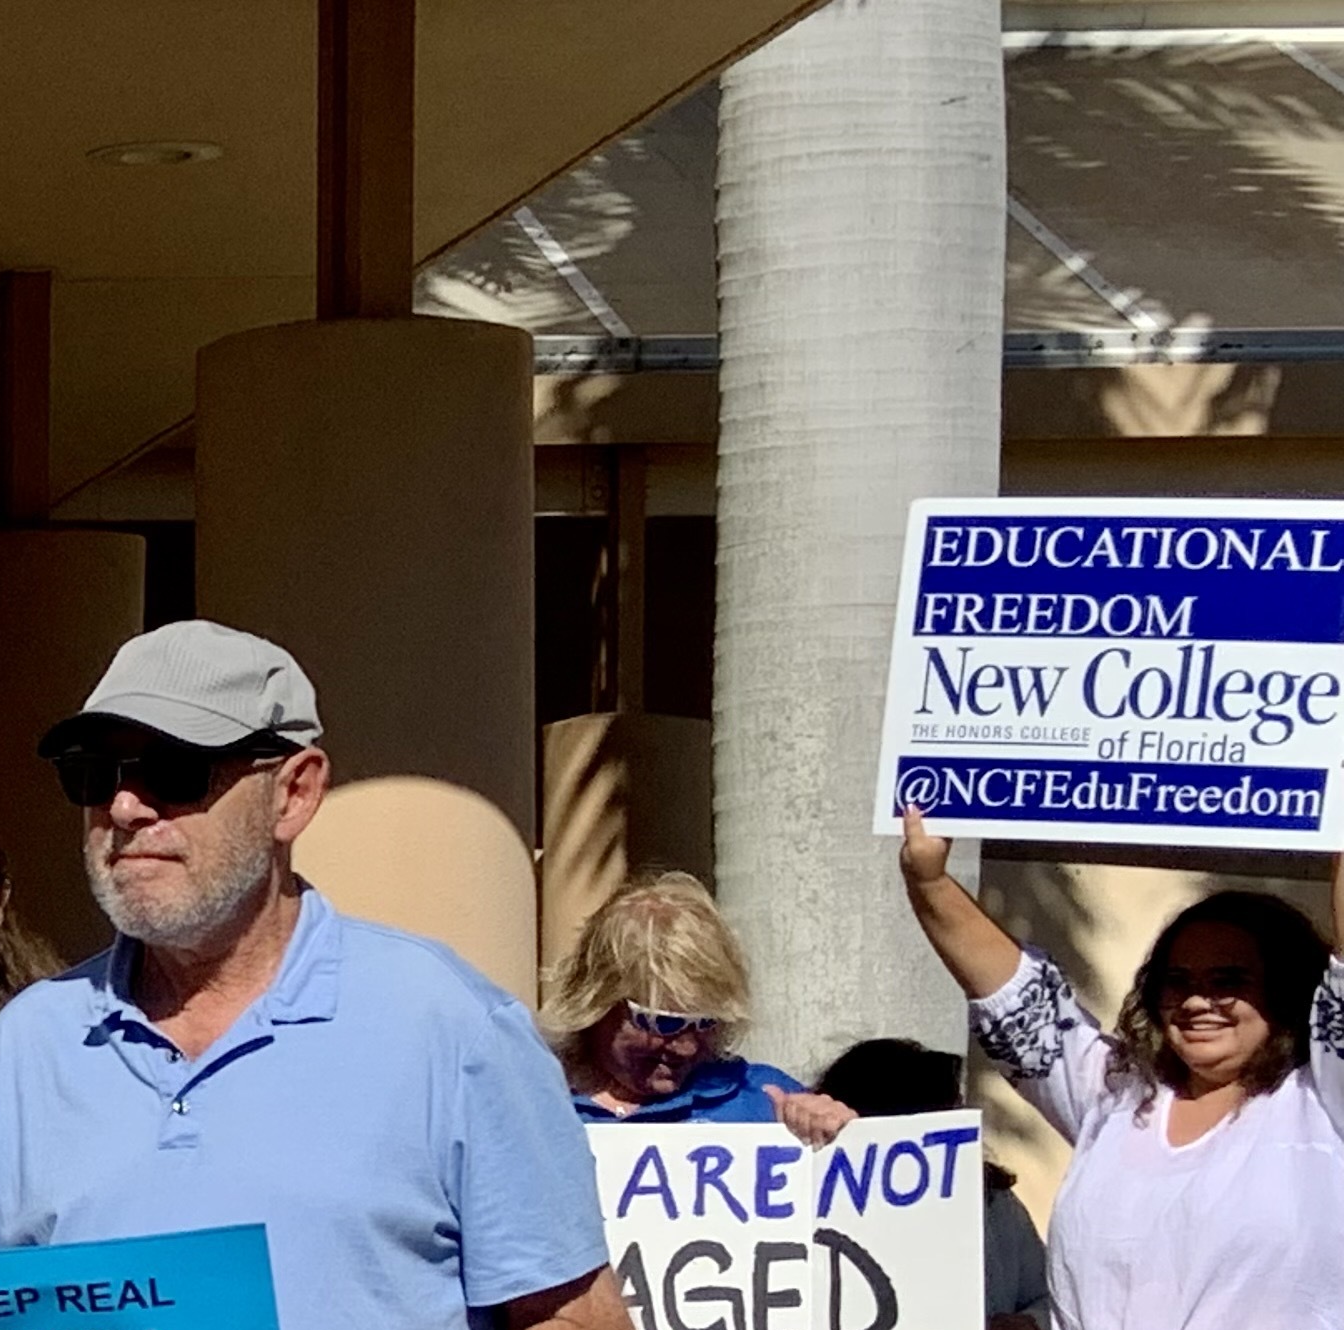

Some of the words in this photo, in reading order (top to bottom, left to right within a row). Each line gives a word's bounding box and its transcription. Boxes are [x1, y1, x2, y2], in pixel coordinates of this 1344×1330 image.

[927, 526, 1343, 572] EDUCATIONAL
[919, 593, 1199, 637] FREEDOM
[914, 647, 1069, 717] New
[1083, 643, 1340, 746] College
[912, 724, 939, 739] THE
[945, 724, 1013, 740] HONORS
[1020, 726, 1091, 742] COLLEGE
[1098, 730, 1129, 760] of
[1139, 730, 1246, 764] Florida
[896, 766, 1321, 817] @NCFEduFreedom
[617, 1144, 802, 1222] ARE
[816, 1127, 980, 1219] NOT
[56, 1277, 176, 1313] REAL
